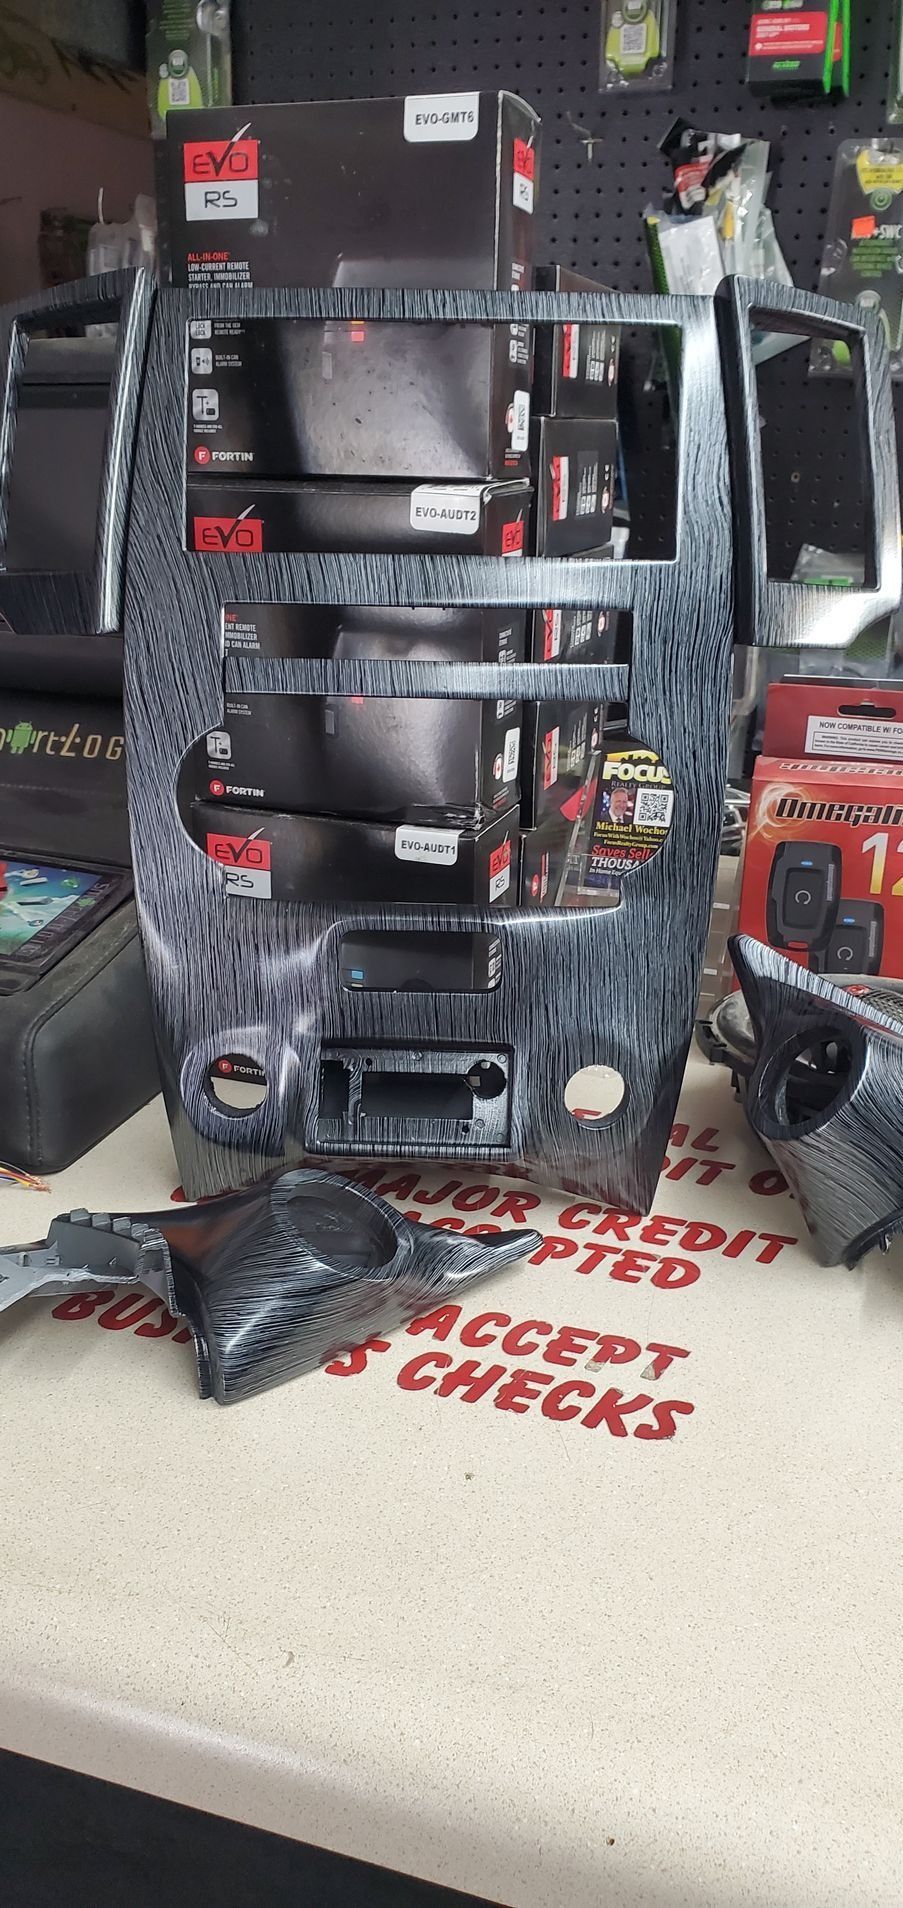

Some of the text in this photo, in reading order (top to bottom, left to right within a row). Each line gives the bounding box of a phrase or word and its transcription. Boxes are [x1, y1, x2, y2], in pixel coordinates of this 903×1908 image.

[415, 111, 475, 126] EVO-GMT6
[204, 190, 238, 208] RS
[187, 261, 249, 272] LOW-CURRENT REMOTE
[213, 272, 251, 281] IMMOBILIZER
[212, 451, 254, 462] FORTIN
[415, 507, 477, 521] EVO-AUDT2
[819, 721, 837, 729] NOW
[837, 723, 881, 733] COMPATIBLE
[892, 727, 903, 735] FO
[225, 785, 265, 797] FORTIN
[595, 821, 633, 833] Michael
[401, 840, 456, 855] EVO-AUDT1
[591, 844, 626, 858] Saves
[591, 856, 642, 870] THOUSA
[226, 872, 254, 888] RS
[559, 1202, 798, 1265] CREDIT
[405, 1304, 691, 1381] ACCEPT
[396, 1351, 695, 1441] CHECKS
